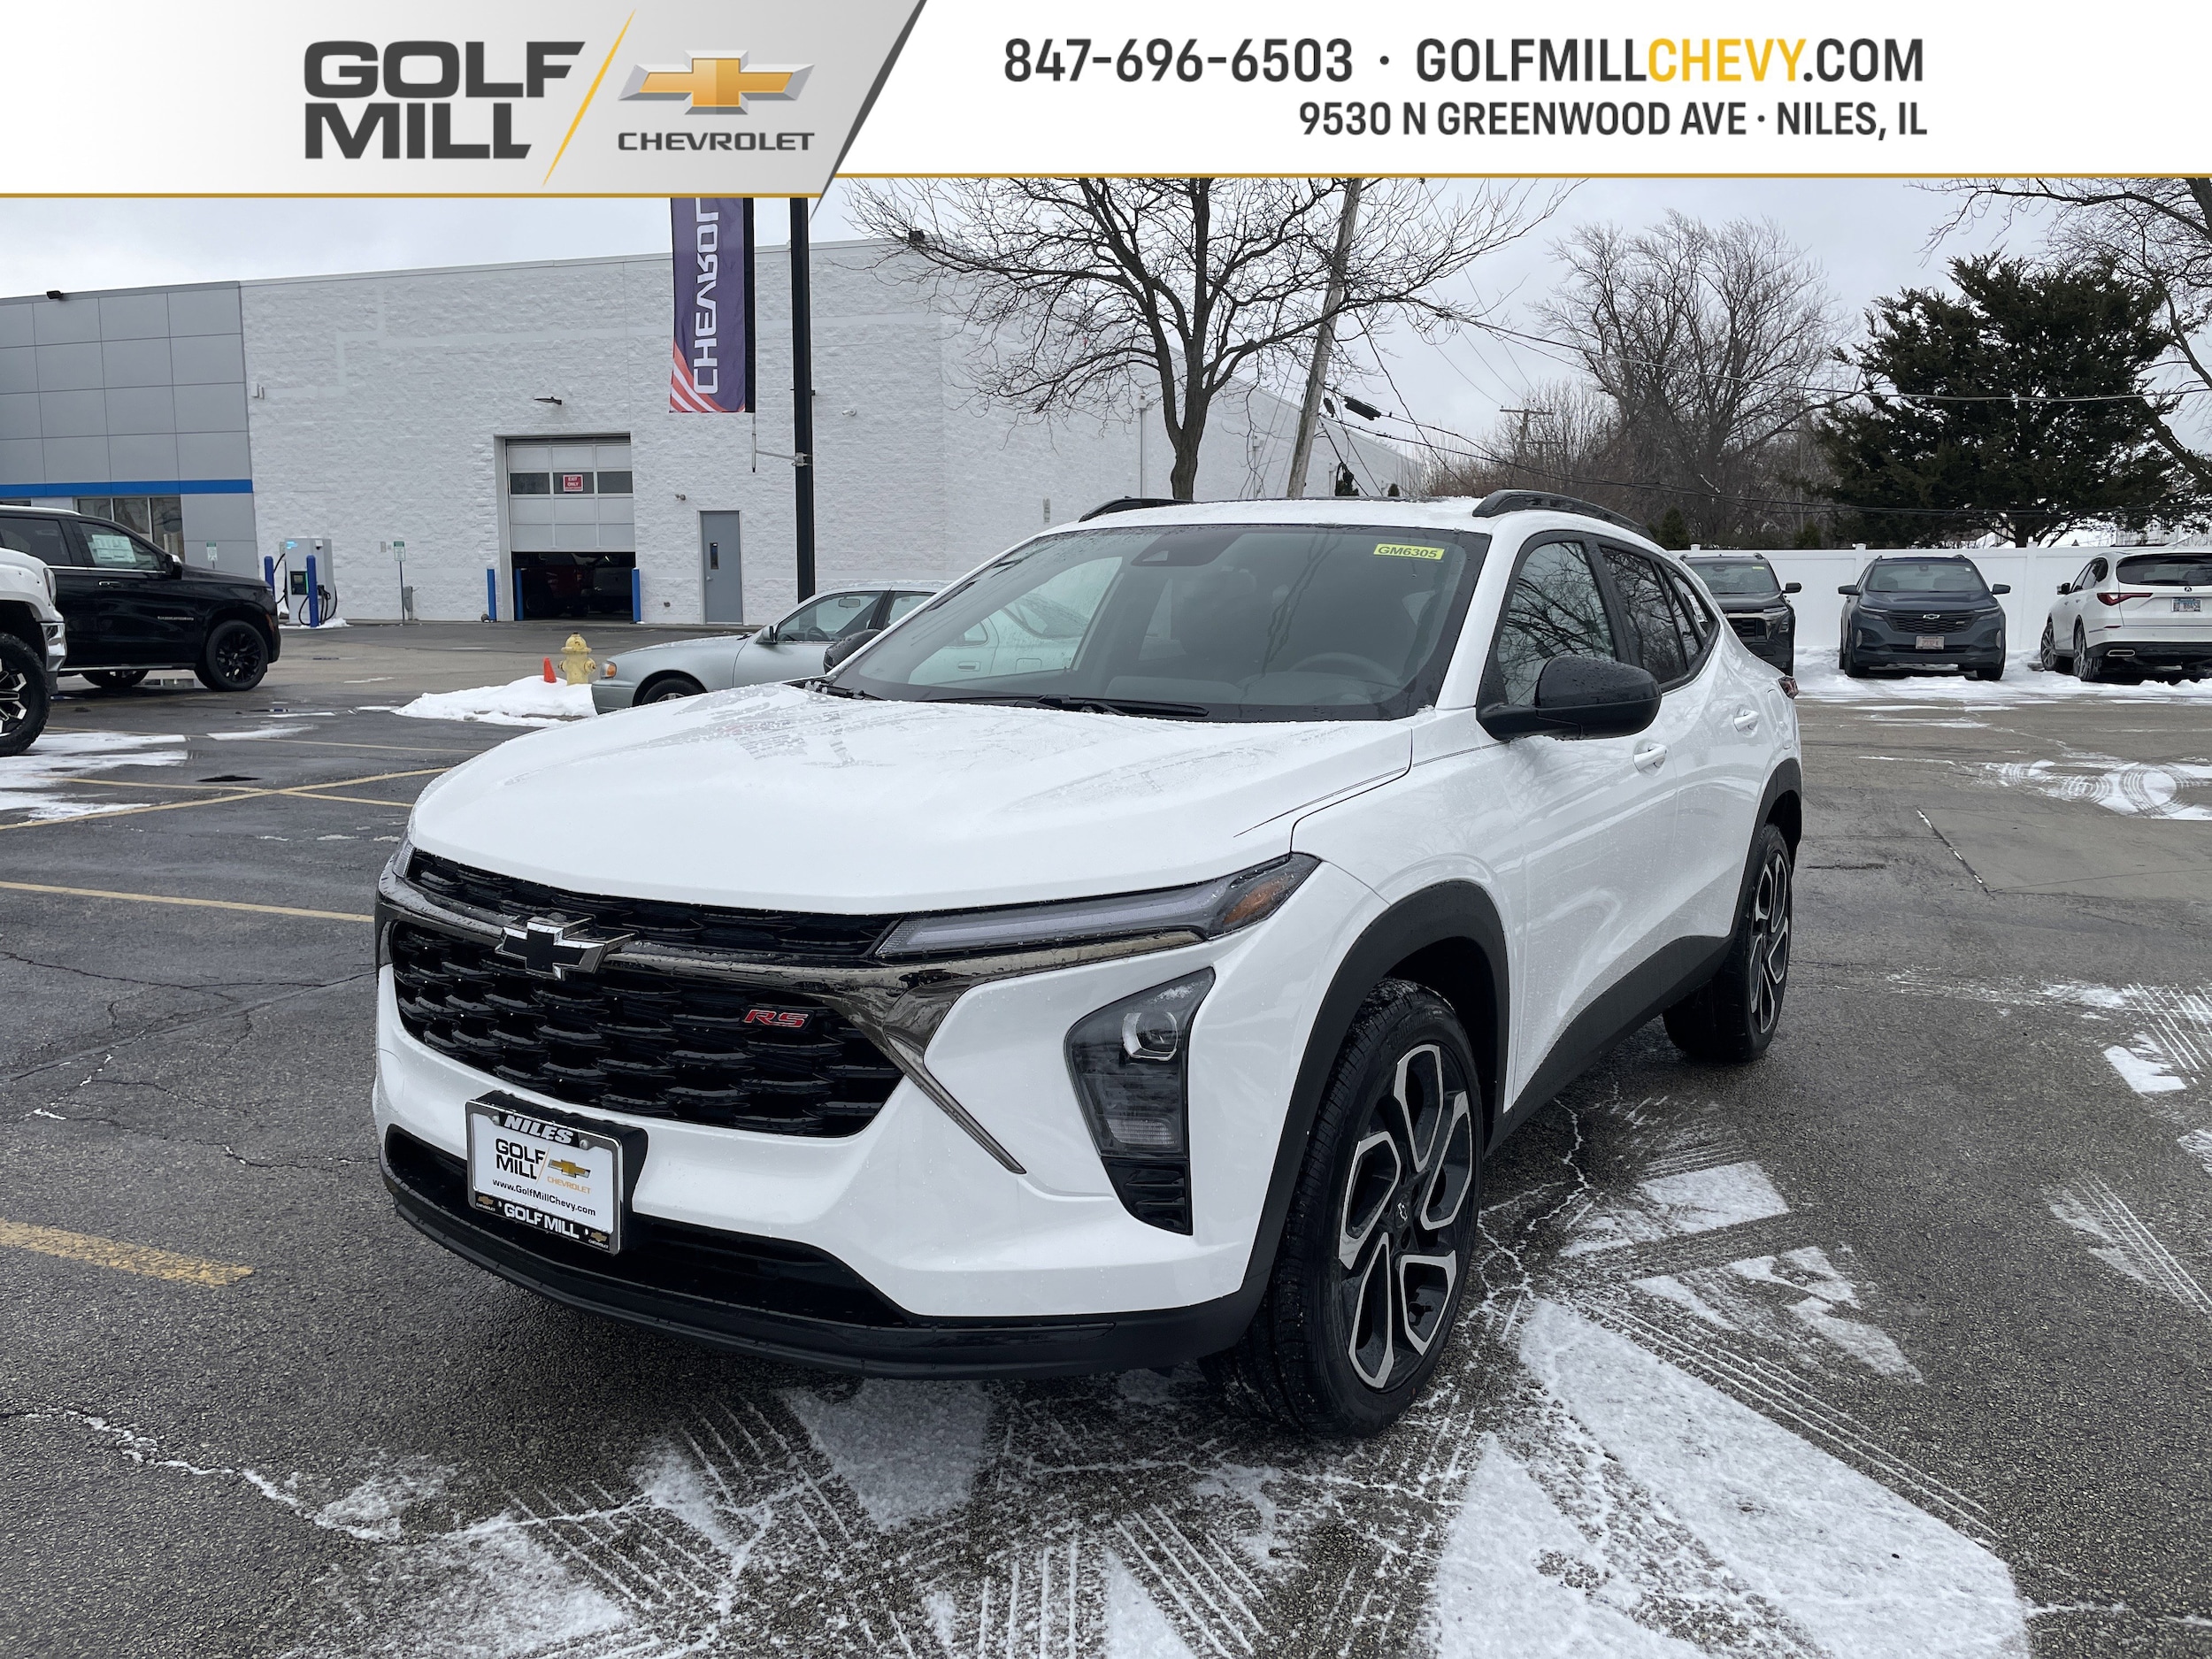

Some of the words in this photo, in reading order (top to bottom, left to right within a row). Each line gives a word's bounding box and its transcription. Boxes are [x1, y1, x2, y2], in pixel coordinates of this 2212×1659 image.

[1378, 547, 1439, 558] GM6305
[743, 1009, 809, 1028] RS
[503, 1115, 574, 1144] NILES
[495, 1138, 546, 1164] GOLF
[496, 1154, 537, 1180] MILL
[492, 1179, 596, 1217] www.GolfMillChevy.com
[547, 1176, 591, 1194] CHEVROLET
[503, 1202, 543, 1226] GOLF
[543, 1215, 580, 1240] MILL
